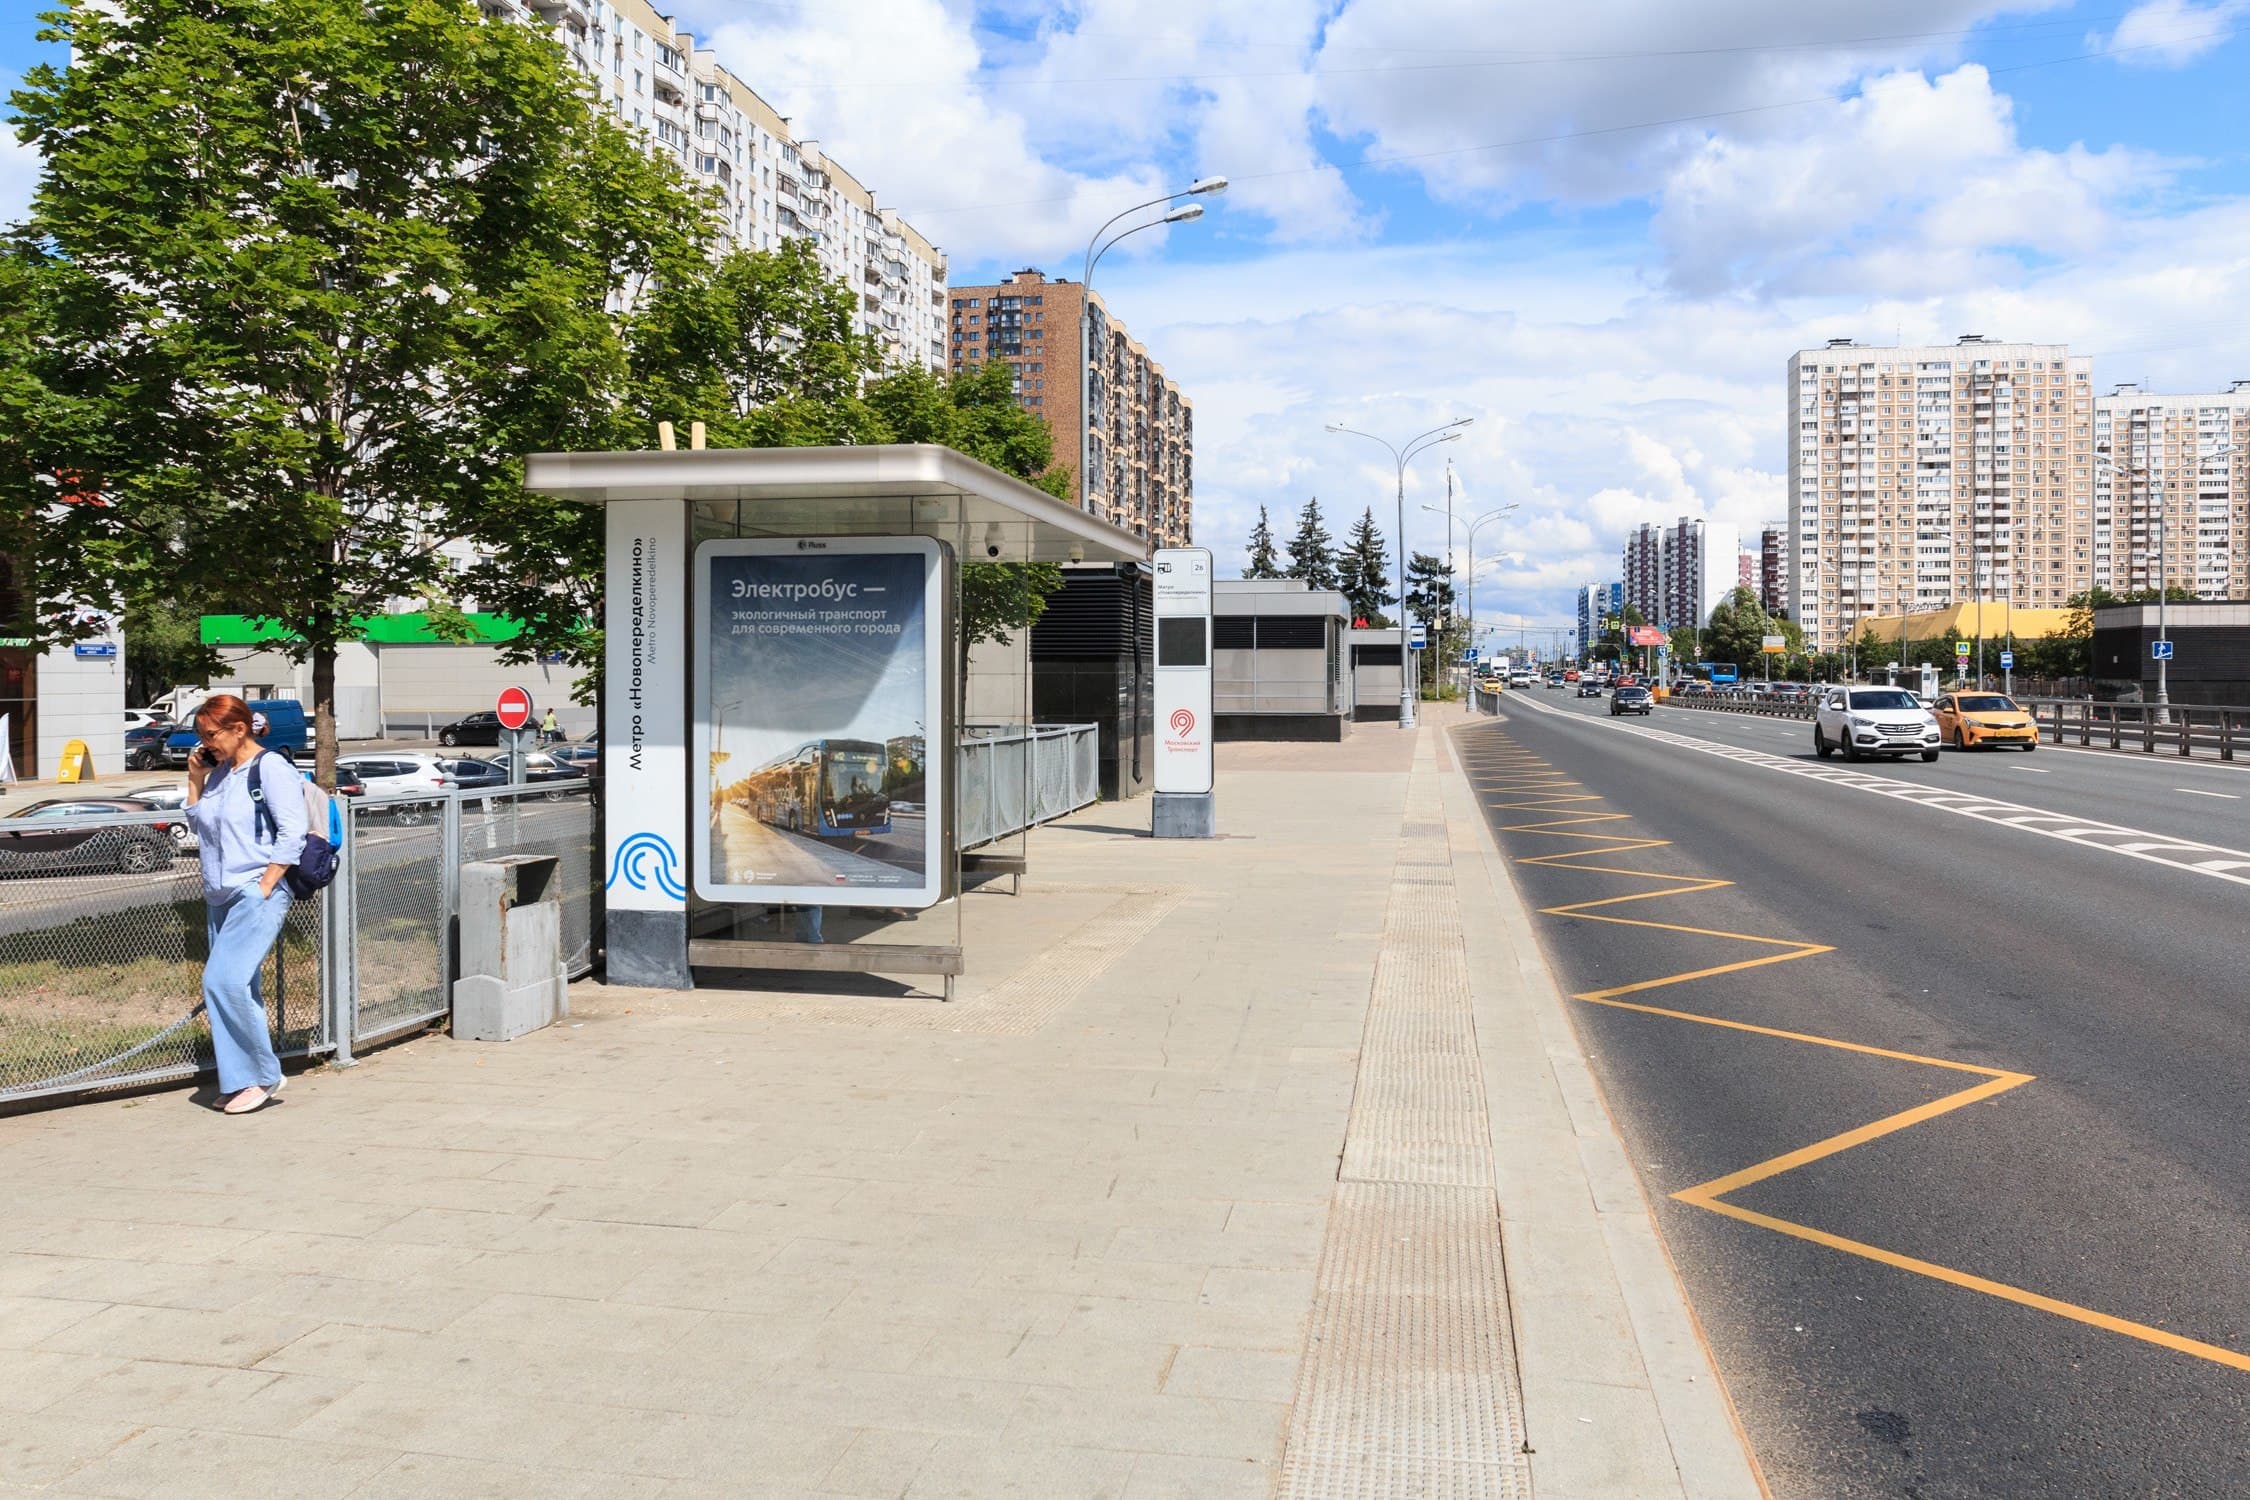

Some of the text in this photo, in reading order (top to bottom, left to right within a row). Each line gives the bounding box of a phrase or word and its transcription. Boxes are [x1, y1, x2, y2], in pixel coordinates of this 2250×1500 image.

[646, 537, 657, 665] Metro Novoperedelkino
[731, 579, 857, 602] Электробус
[731, 609, 888, 622] экологичный транспорт
[731, 624, 901, 636] для современного города
[629, 537, 645, 771] Метро «Новопеределкино»
